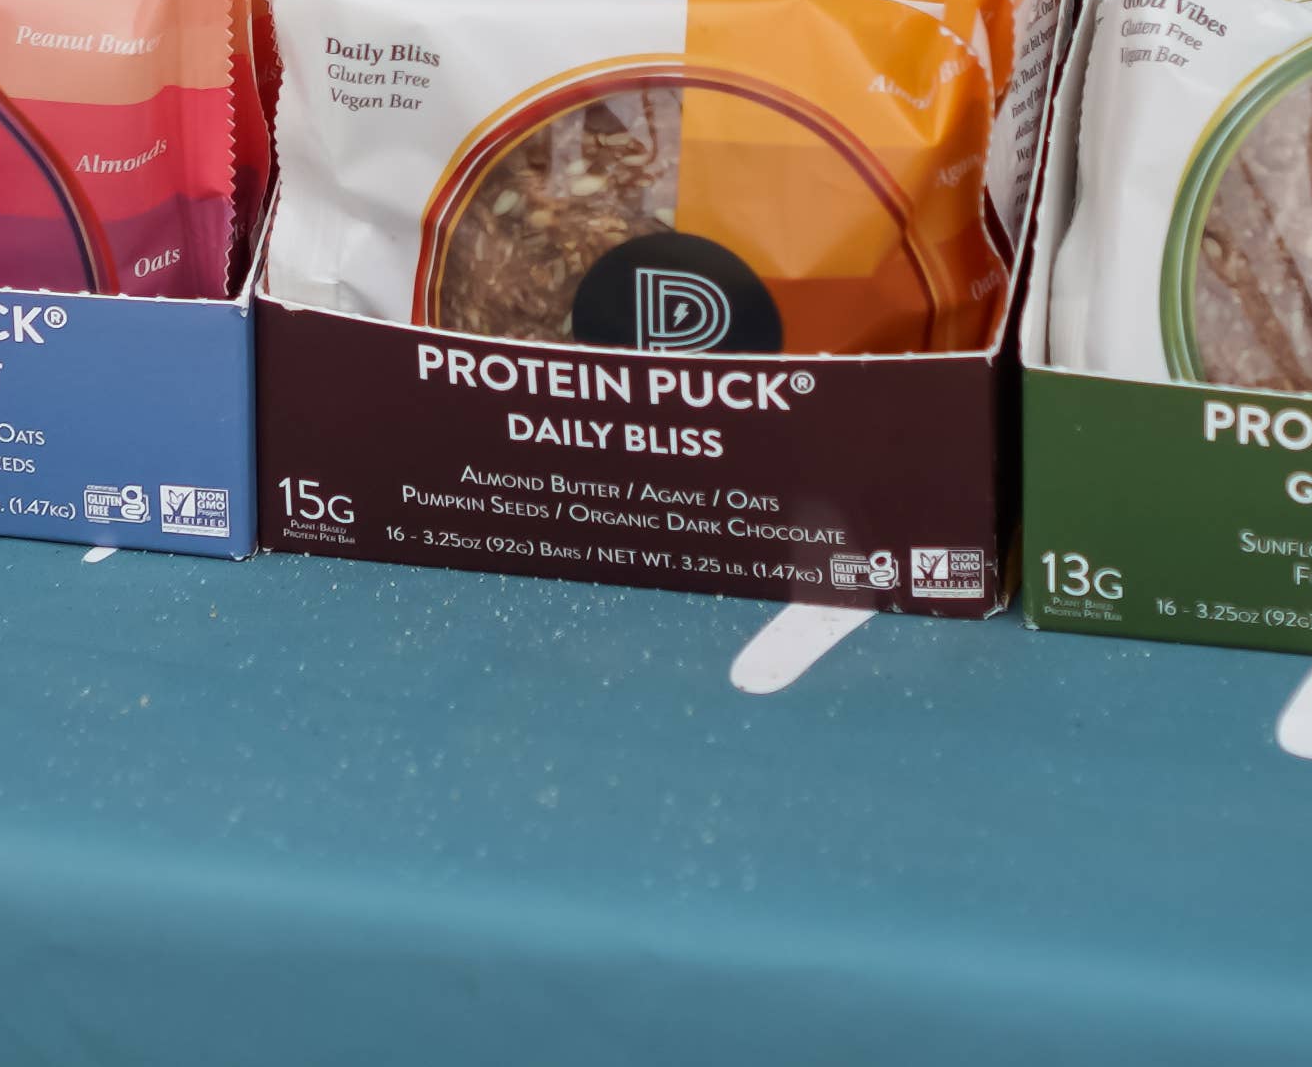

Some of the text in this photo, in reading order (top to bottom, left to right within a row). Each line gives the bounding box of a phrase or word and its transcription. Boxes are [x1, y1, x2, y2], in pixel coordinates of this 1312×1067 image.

[16, 25, 94, 51] Peanut
[1167, 22, 1203, 52] Free
[325, 37, 441, 68] Daily Bliss
[1155, 46, 1190, 69] Bar
[327, 63, 431, 89] Gluten Free
[330, 87, 423, 112] Vegan Bar
[75, 139, 168, 174] Almonds
[134, 248, 181, 278] Oats
[417, 343, 632, 404] PROTEIN
[507, 413, 724, 458] DAILY BLISS
[88, 493, 122, 507] GLUTEN
[196, 490, 225, 501] NON
[196, 499, 226, 510] GMO
[88, 505, 110, 518] FREE
[165, 515, 226, 527] VERIFIED
[386, 526, 405, 543] 16
[597, 548, 636, 566] NET
[642, 551, 676, 570] WT.
[681, 556, 721, 574] 3.25
[951, 552, 980, 562] NON
[951, 561, 981, 571] GMO
